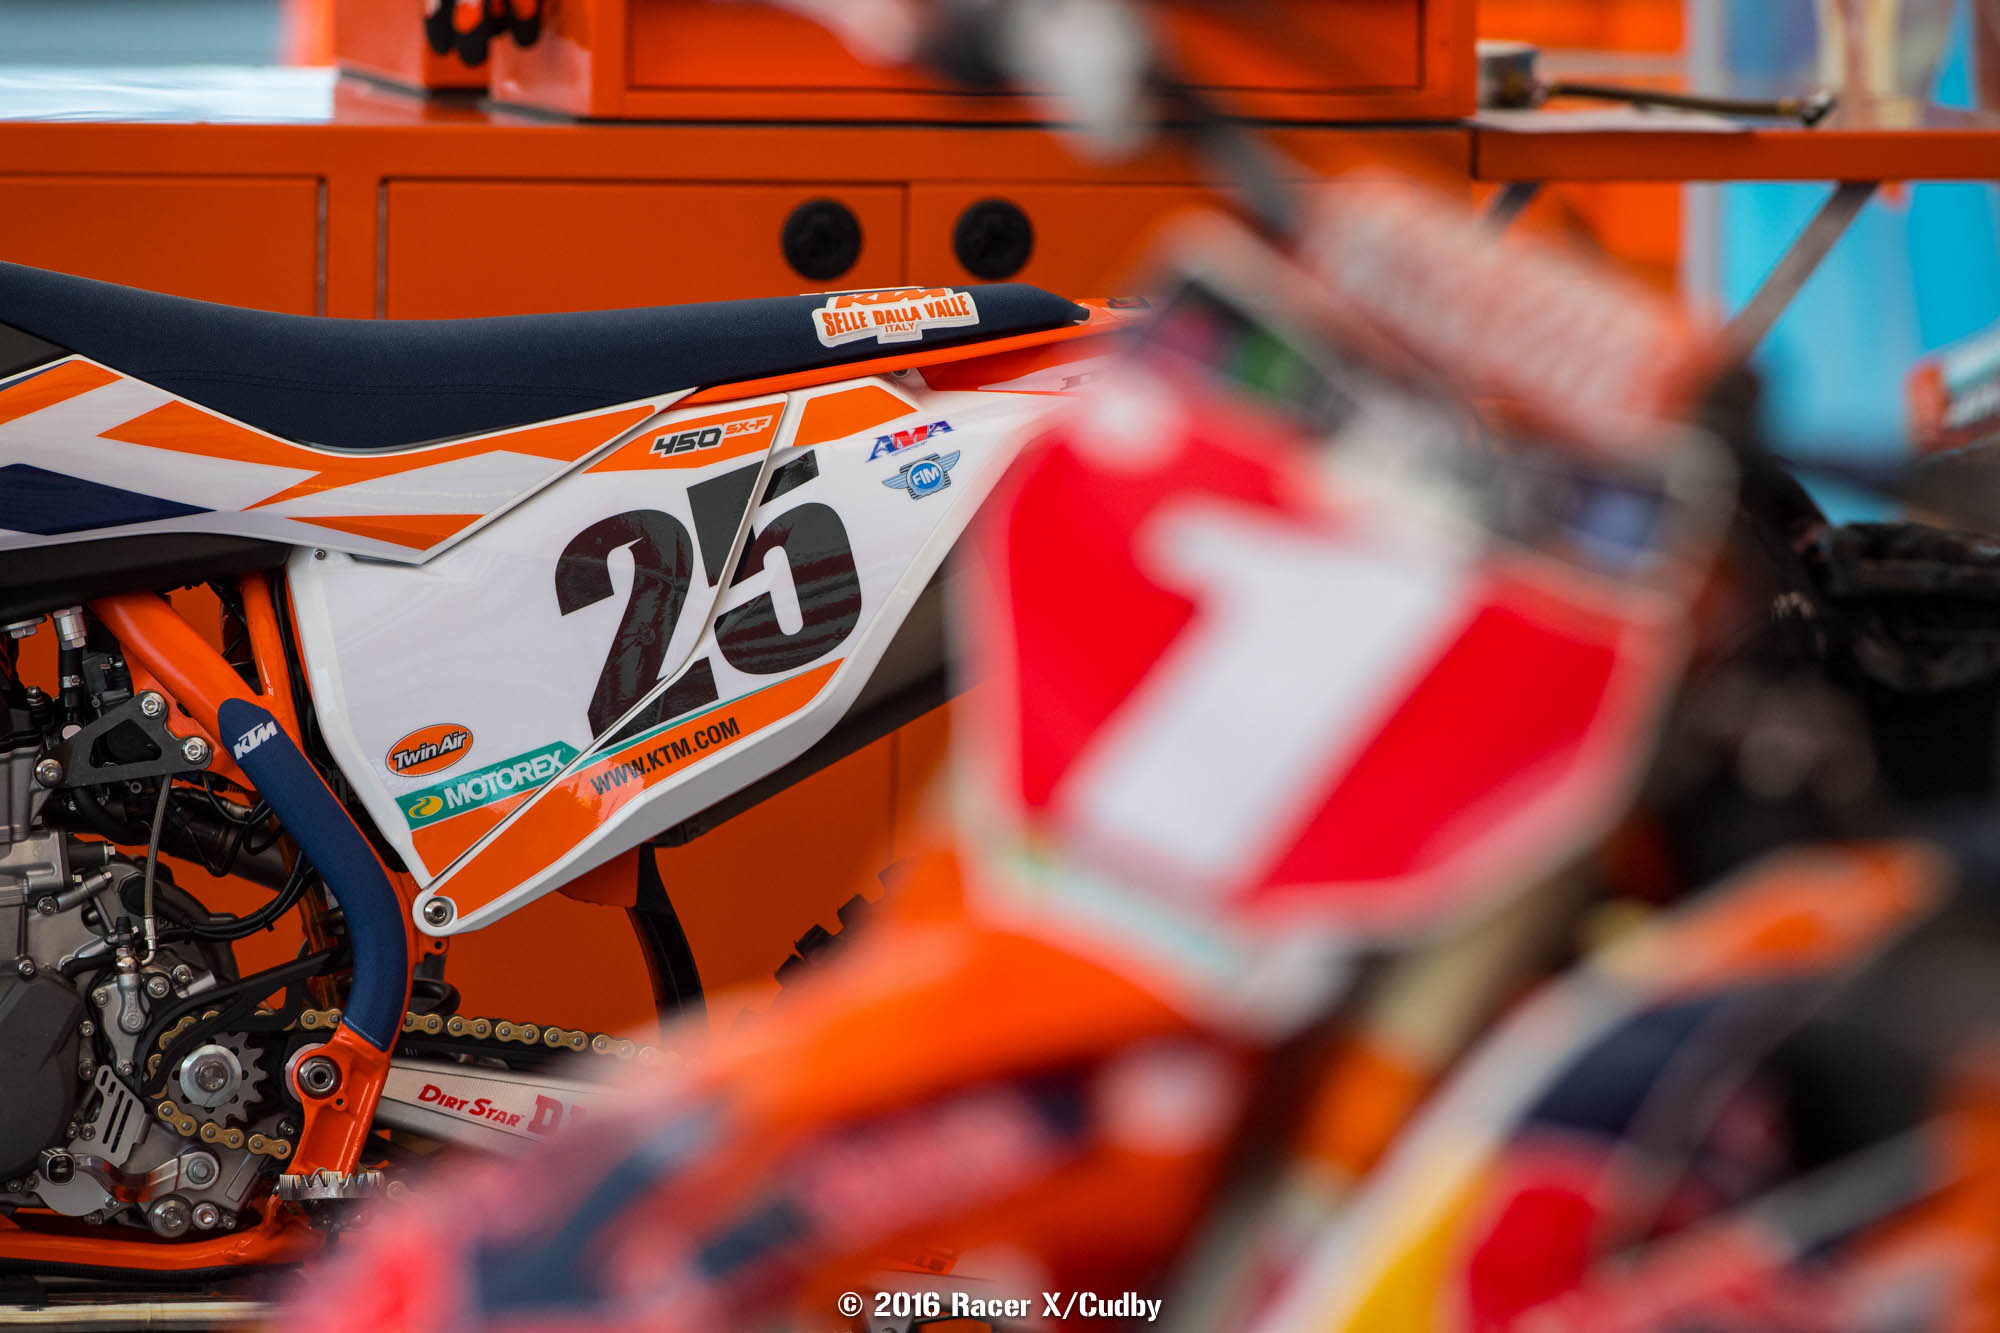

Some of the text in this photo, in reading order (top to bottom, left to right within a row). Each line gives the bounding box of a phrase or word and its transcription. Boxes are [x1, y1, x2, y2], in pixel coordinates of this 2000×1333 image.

[822, 295, 970, 337] SELLE DALLA VALLE
[885, 322, 915, 333] ITALY
[653, 418, 769, 455] 450 SX-F
[866, 420, 956, 463] AMA
[912, 466, 940, 486] FIM
[554, 449, 862, 754] 25
[233, 721, 278, 760] KTM
[393, 730, 467, 771] Twin Air
[590, 717, 740, 796] WWW.KTM.COM
[444, 749, 566, 809] MOTOREX
